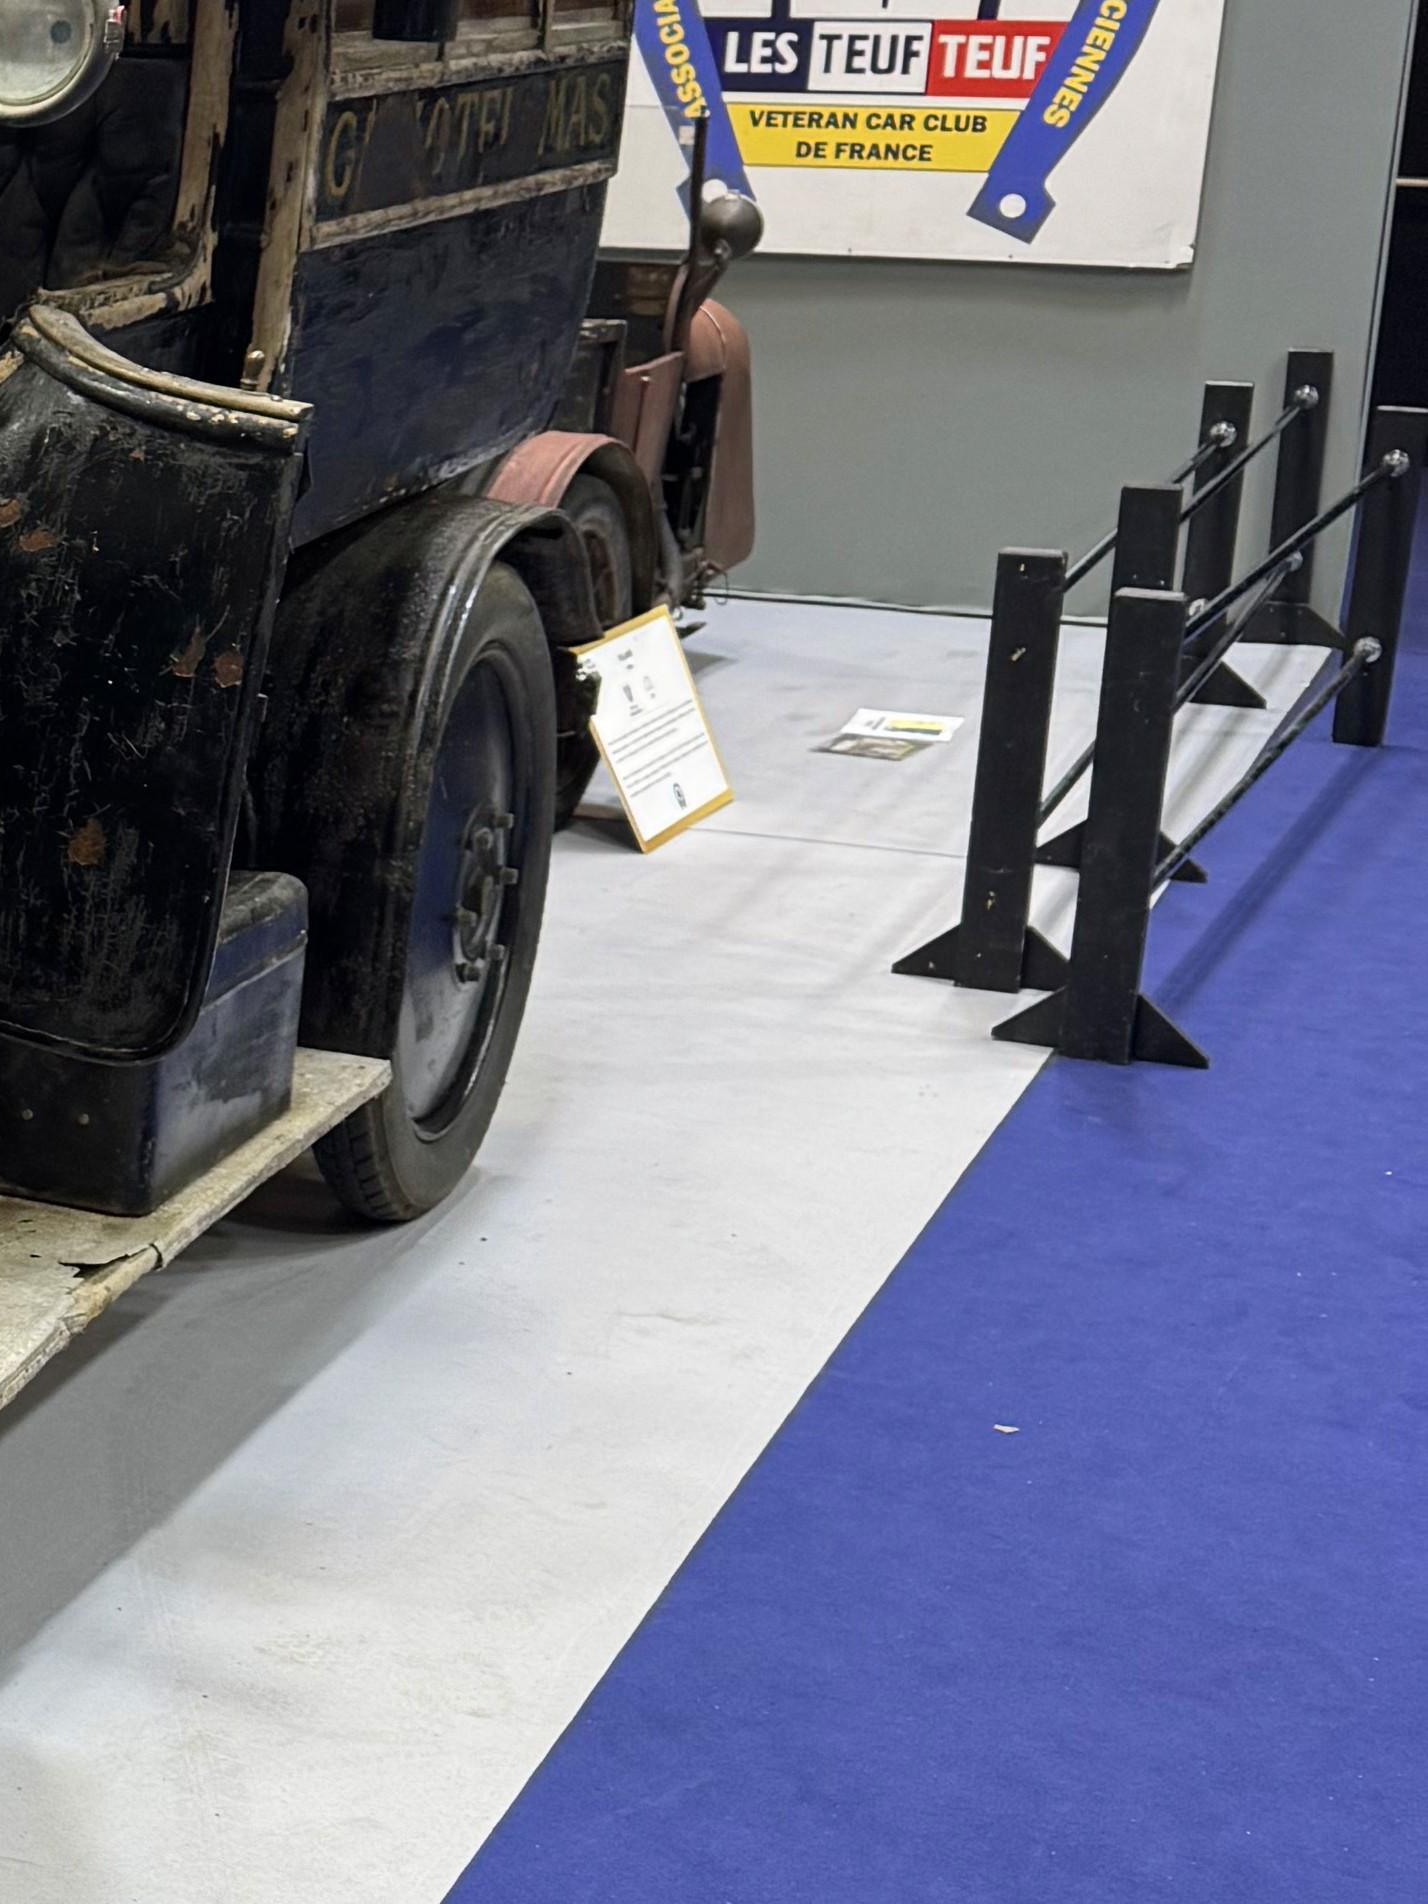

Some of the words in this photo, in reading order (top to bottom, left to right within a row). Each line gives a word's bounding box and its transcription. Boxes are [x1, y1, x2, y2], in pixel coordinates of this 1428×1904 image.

[722, 28, 800, 77] LES
[818, 30, 925, 78] TEUF
[938, 33, 1052, 83] TEUF
[748, 108, 860, 131] VETERAN
[865, 110, 919, 133] CAR
[924, 112, 987, 134] CLUB
[794, 139, 828, 160] DE
[834, 140, 933, 163] FRANCE
